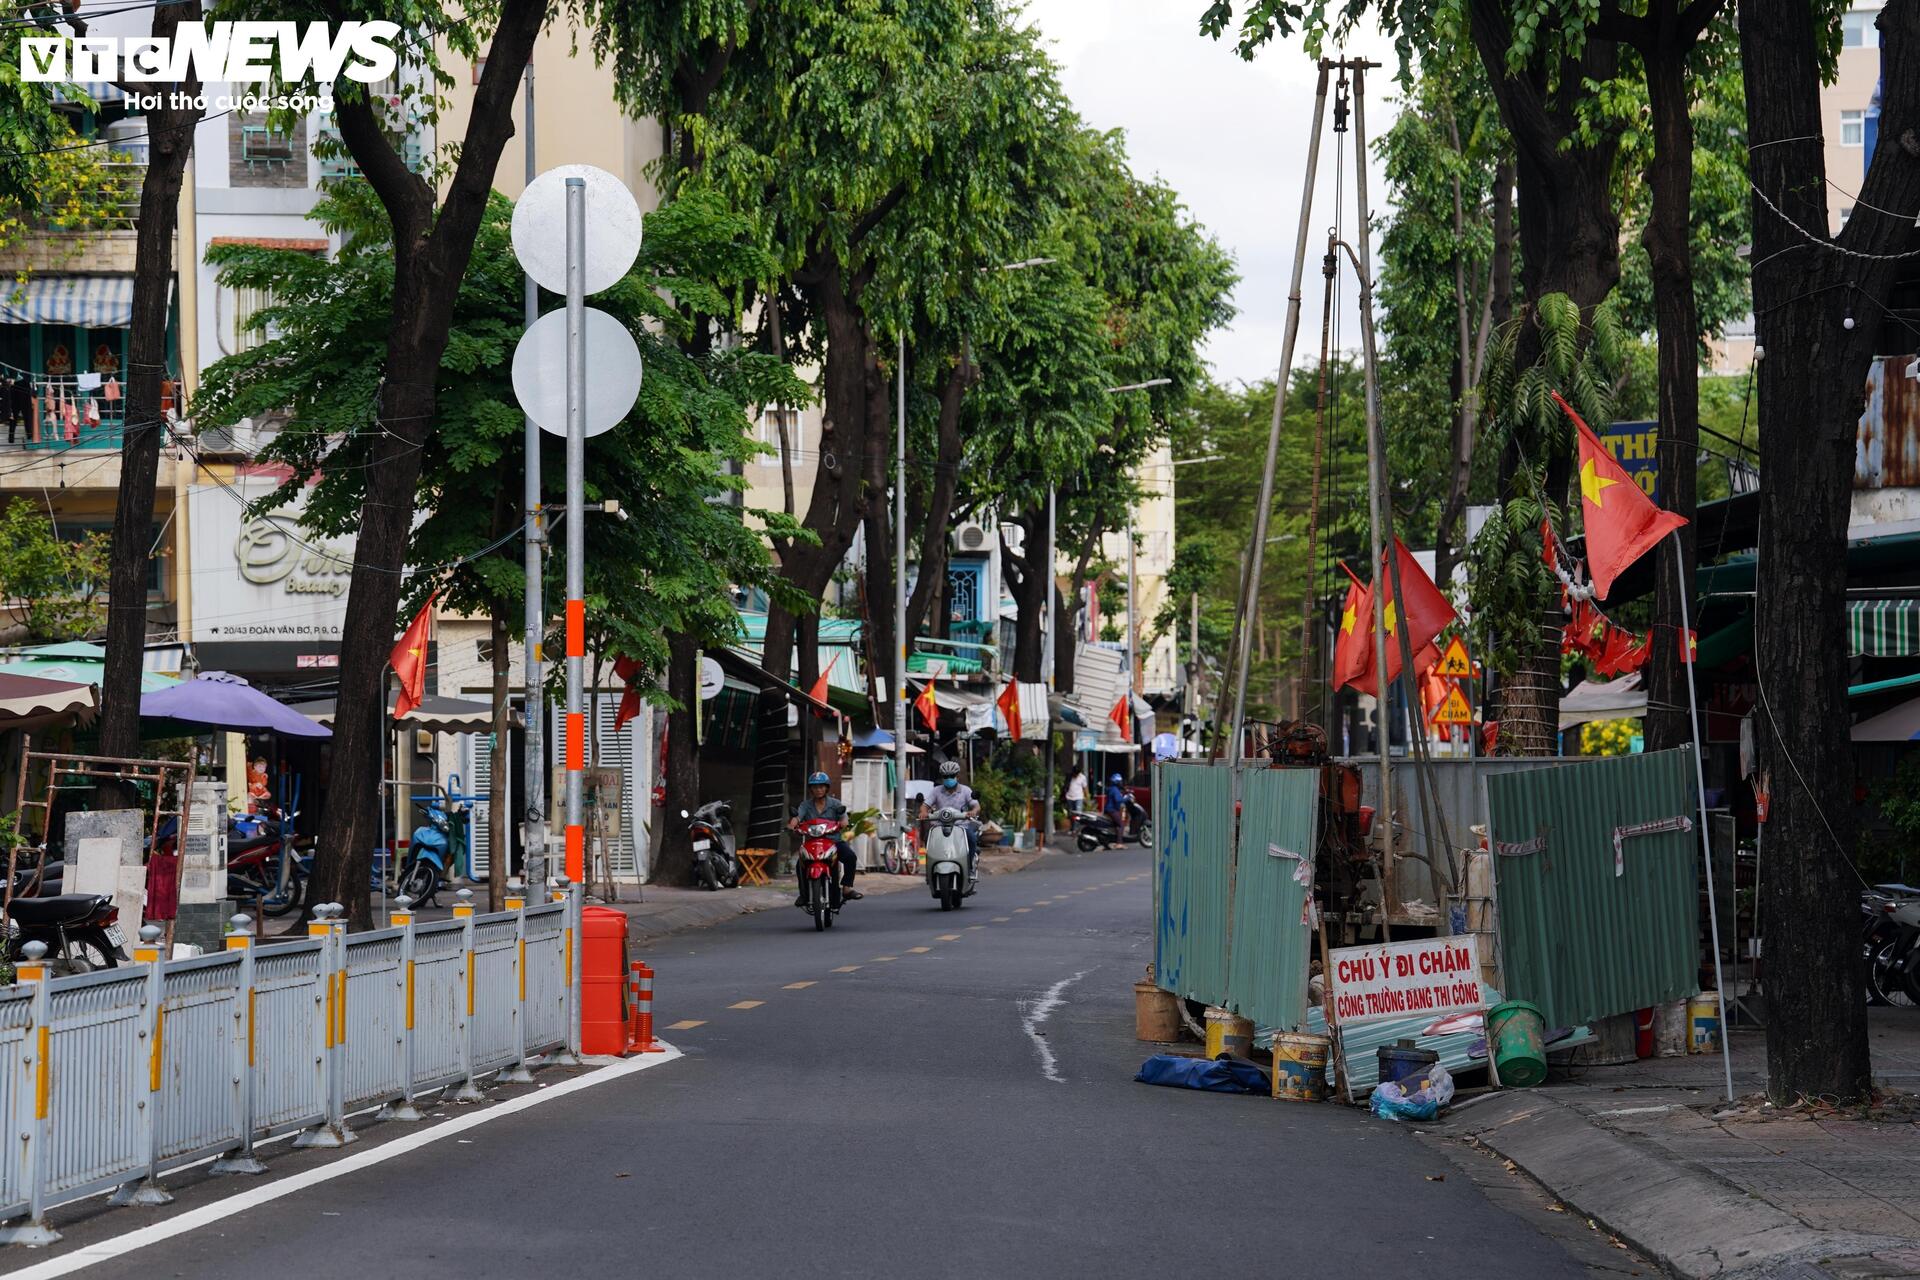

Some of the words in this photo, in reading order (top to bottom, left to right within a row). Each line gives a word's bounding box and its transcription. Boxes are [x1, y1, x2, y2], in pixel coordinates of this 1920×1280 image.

[224, 626, 247, 634] 20/43
[1338, 952, 1375, 983] CHÚ
[1379, 951, 1391, 978] Ý
[1396, 954, 1415, 977] ĐI
[1419, 945, 1471, 979] CHẬM
[1337, 991, 1365, 1018] CÔNG
[1366, 986, 1405, 1015] TRƯỜNG
[1406, 987, 1433, 1010] ĐANG
[1434, 986, 1451, 1007] THI
[1452, 979, 1480, 1005] CÔNG
